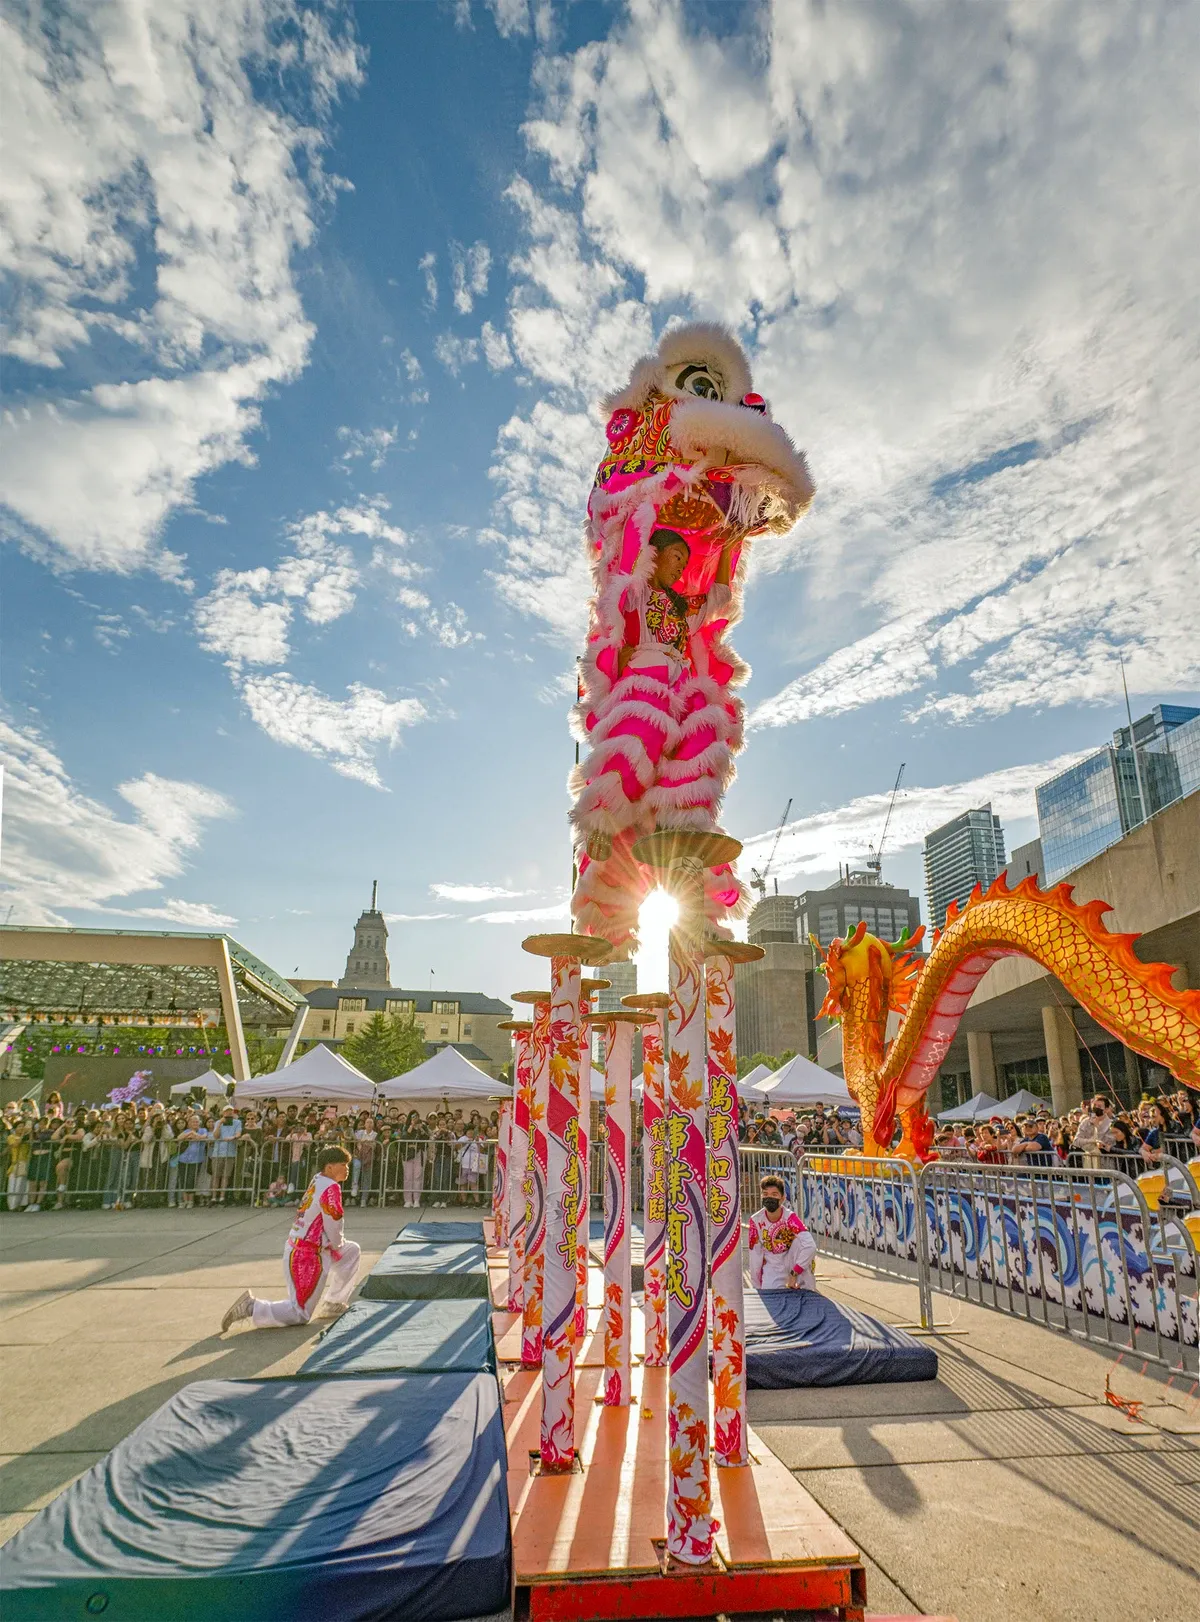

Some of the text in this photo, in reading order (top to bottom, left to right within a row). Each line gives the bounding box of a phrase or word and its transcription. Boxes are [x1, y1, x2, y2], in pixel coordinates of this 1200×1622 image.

[668, 1111, 693, 1308] 事業有成
[709, 1074, 732, 1224] 萬事如意
